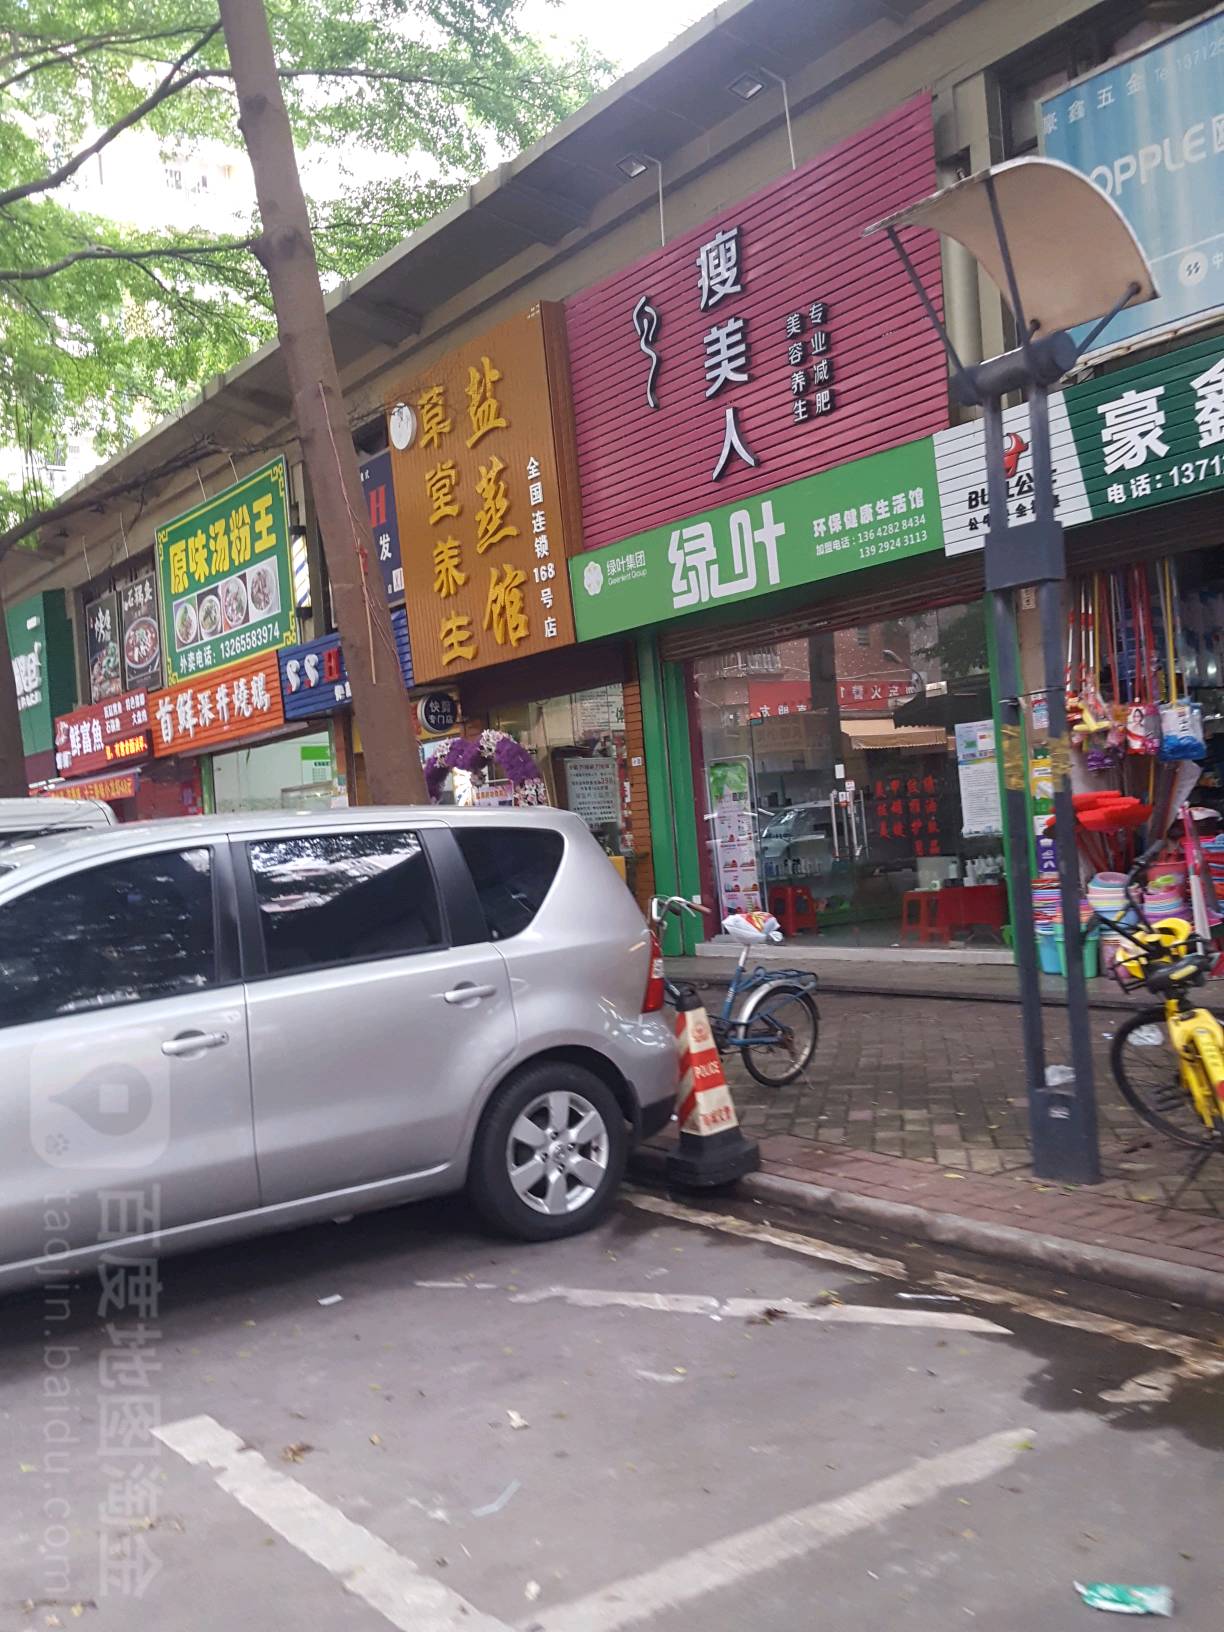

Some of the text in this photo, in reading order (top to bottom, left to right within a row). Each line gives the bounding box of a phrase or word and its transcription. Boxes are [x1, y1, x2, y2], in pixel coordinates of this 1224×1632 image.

[1089, 123, 1207, 196] OPPLE
[696, 225, 760, 482] 瘦美人
[786, 312, 809, 423] 美容养生
[809, 302, 832, 415] 专业减肥
[169, 493, 277, 595] 原味汤粉王
[379, 533, 392, 561] 发
[526, 456, 558, 638] 全国连锁168号店
[667, 501, 786, 609] 绿叶
[812, 487, 924, 538] 环保健康生活馆
[859, 529, 928, 559] 139 2924 3113
[876, 521, 900, 538] 4282
[901, 513, 926, 531] 8434
[606, 550, 646, 577] 绿叶集团
